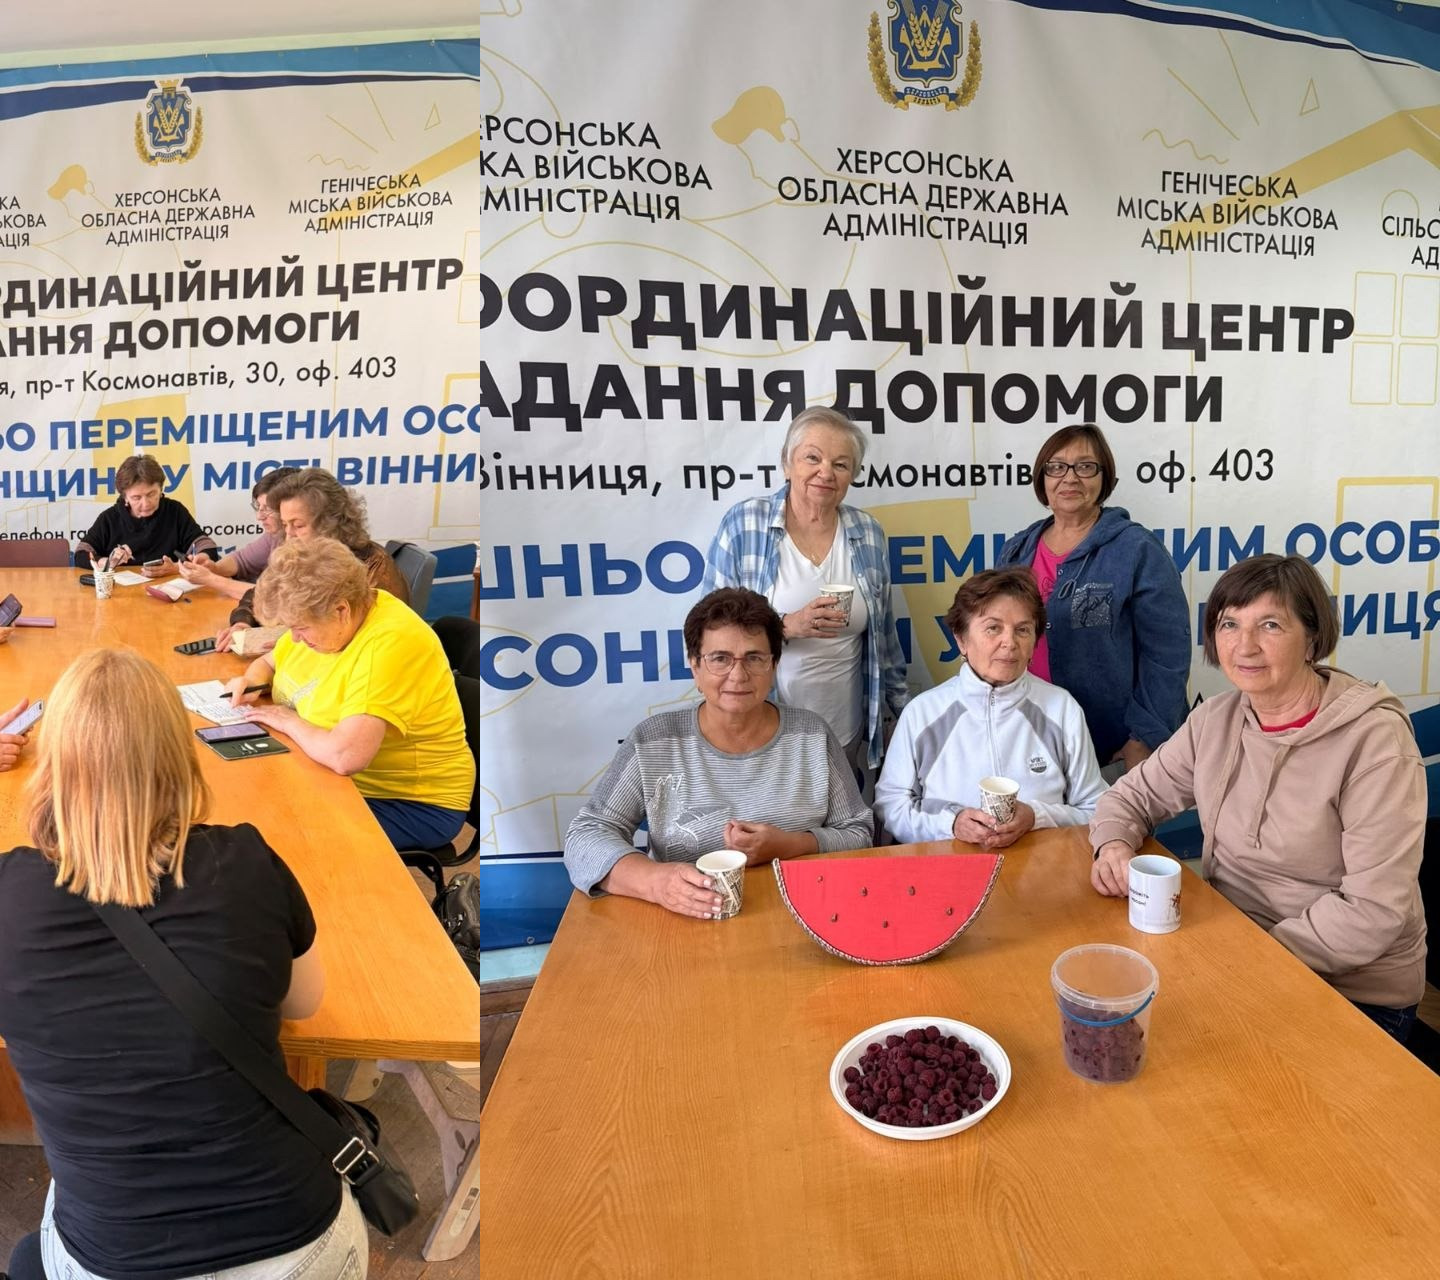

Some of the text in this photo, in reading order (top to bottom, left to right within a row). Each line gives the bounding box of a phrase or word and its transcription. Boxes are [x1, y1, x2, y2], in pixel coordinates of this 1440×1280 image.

[480, 114, 661, 150] РСОНСЬКА
[534, 149, 713, 190] ВІЙСЬКОВА
[836, 147, 1014, 183] ХЕРСОНСЬКА
[114, 187, 221, 208] ХЕРСОНСЬКА
[320, 173, 422, 194] ГЕНІЧЕСЬКА
[777, 176, 1069, 216] ОБЛАСНА ДЕРЖАВНА
[1161, 170, 1298, 199] ГЕНІЧЕСЬКА
[80, 204, 256, 228] ОБЛАСНА ДЕРЖАВНА
[288, 191, 453, 214] МІСЬКА ВІЙСЬКОВА
[480, 184, 681, 223] МІНІСТРАЦІЯ
[1117, 196, 1339, 231] МІСЬКА ВІЙСЬКОВА
[105, 224, 230, 247] АДМІНІСТРАЦІЯ
[304, 210, 434, 233] АДМІНІСТРАЦІЯ
[822, 213, 1028, 249] АДМІНІСТРАЦІЯ
[1141, 228, 1315, 259] АДМІНІСТРАЦІЯ
[1411, 245, 1440, 270] АД
[316, 258, 464, 302] ЦЕНТР
[103, 310, 360, 359] ДОПОМОГИ
[1161, 302, 1355, 362] ЦЕНТР
[25, 378, 75, 401] пр-т
[82, 364, 235, 392] Космонавтів,
[245, 361, 286, 388] 30,
[295, 358, 339, 389] оф.
[347, 356, 397, 379] 403
[831, 369, 1223, 434] ДОПОМОГИ
[49, 406, 389, 452] ПЕРЕМІЩЕНИМ
[337, 453, 477, 486] ВІННИ
[683, 464, 776, 501] пр-т
[851, 451, 1033, 488] смонавтів
[1136, 450, 1196, 493] оф.
[1209, 447, 1274, 482] 403
[1285, 520, 1440, 566] ОСОБ
